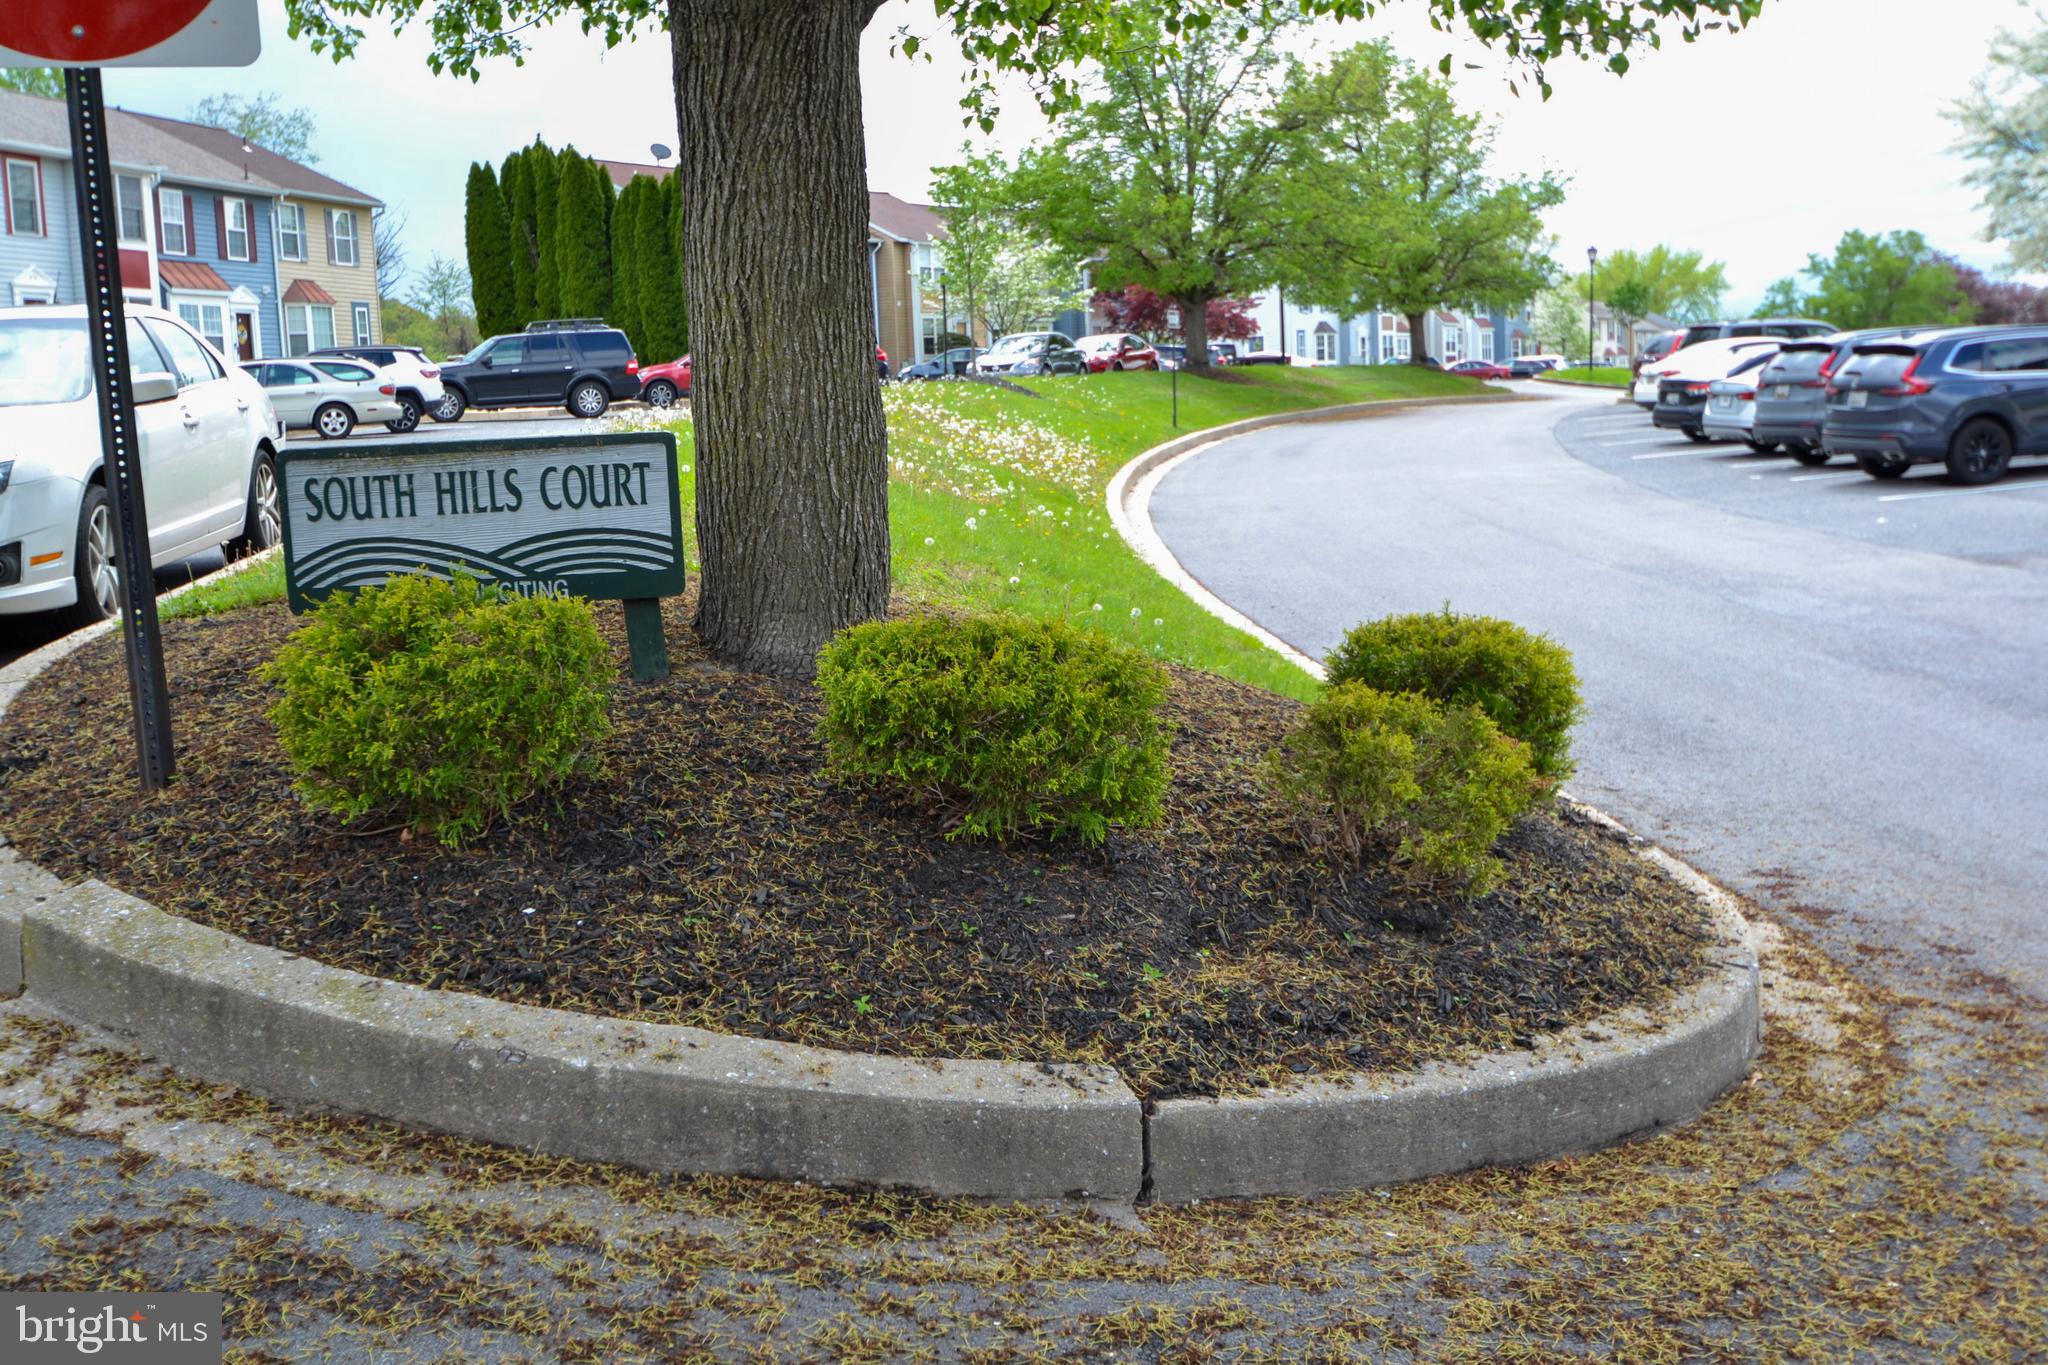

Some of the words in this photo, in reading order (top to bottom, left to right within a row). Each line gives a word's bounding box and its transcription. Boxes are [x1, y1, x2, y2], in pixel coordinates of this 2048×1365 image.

[303, 473, 418, 522] SOUTH
[434, 467, 523, 516] HILLS
[539, 461, 650, 511] COURT
